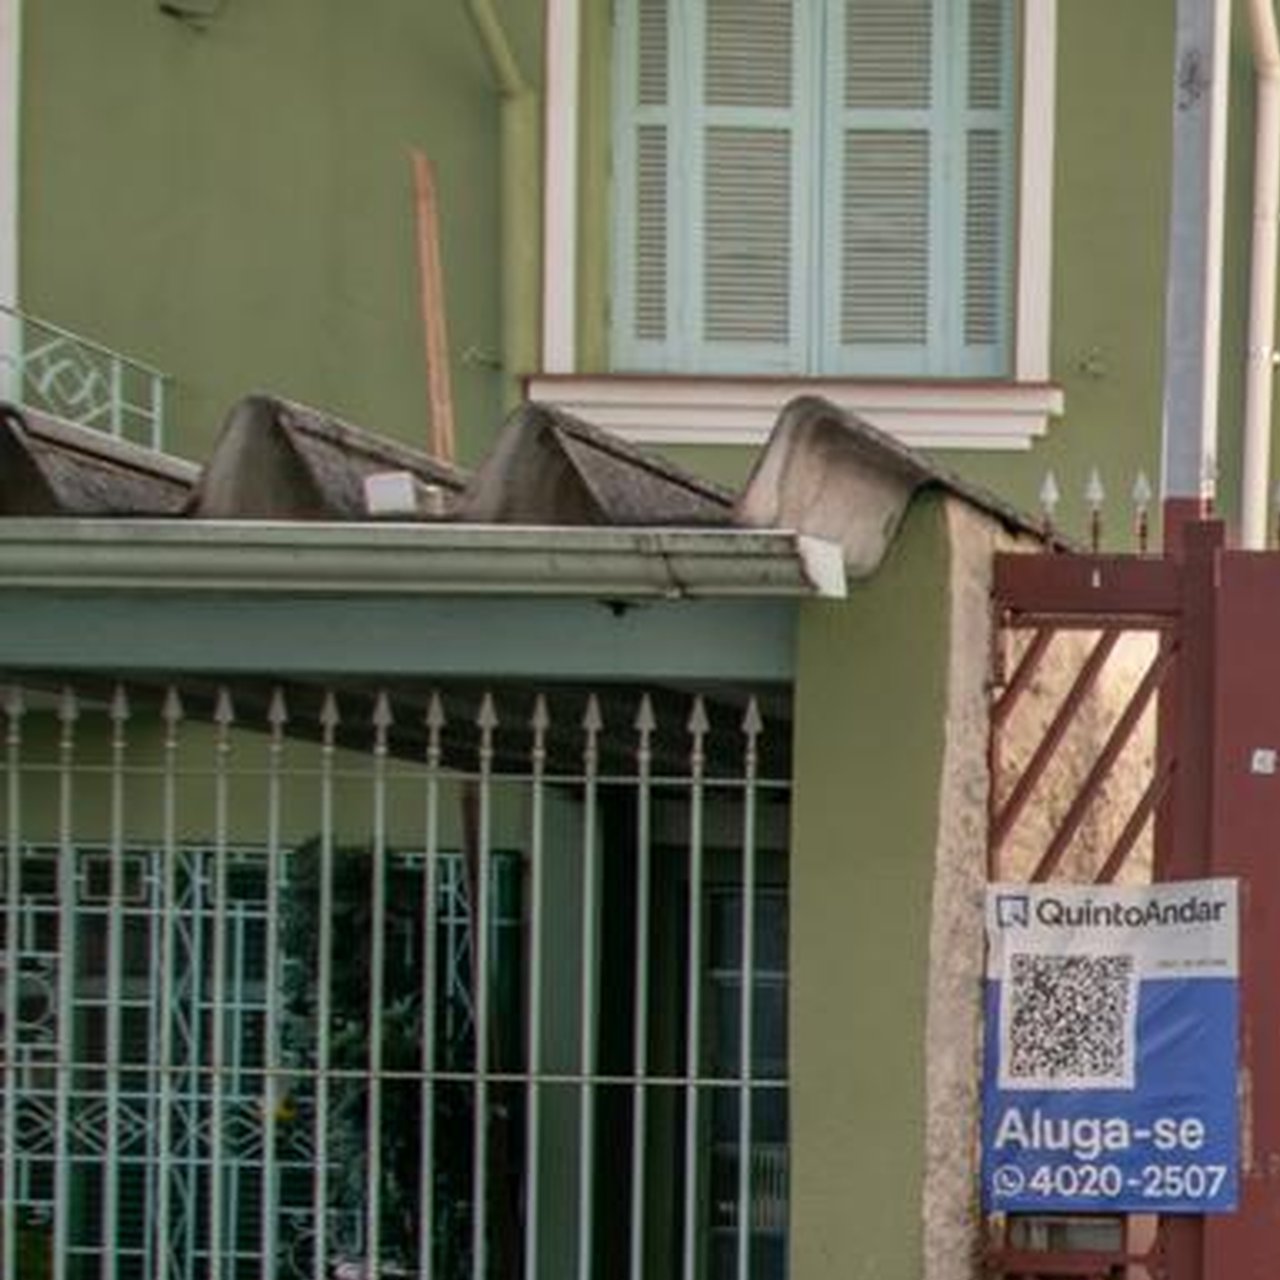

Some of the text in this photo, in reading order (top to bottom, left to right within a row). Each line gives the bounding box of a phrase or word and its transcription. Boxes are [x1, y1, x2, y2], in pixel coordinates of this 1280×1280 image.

[1036, 897, 1227, 928] QuintoAndar
[994, 1109, 1205, 1159] Aluga-se
[1030, 1165, 1227, 1197] 4020-2507
